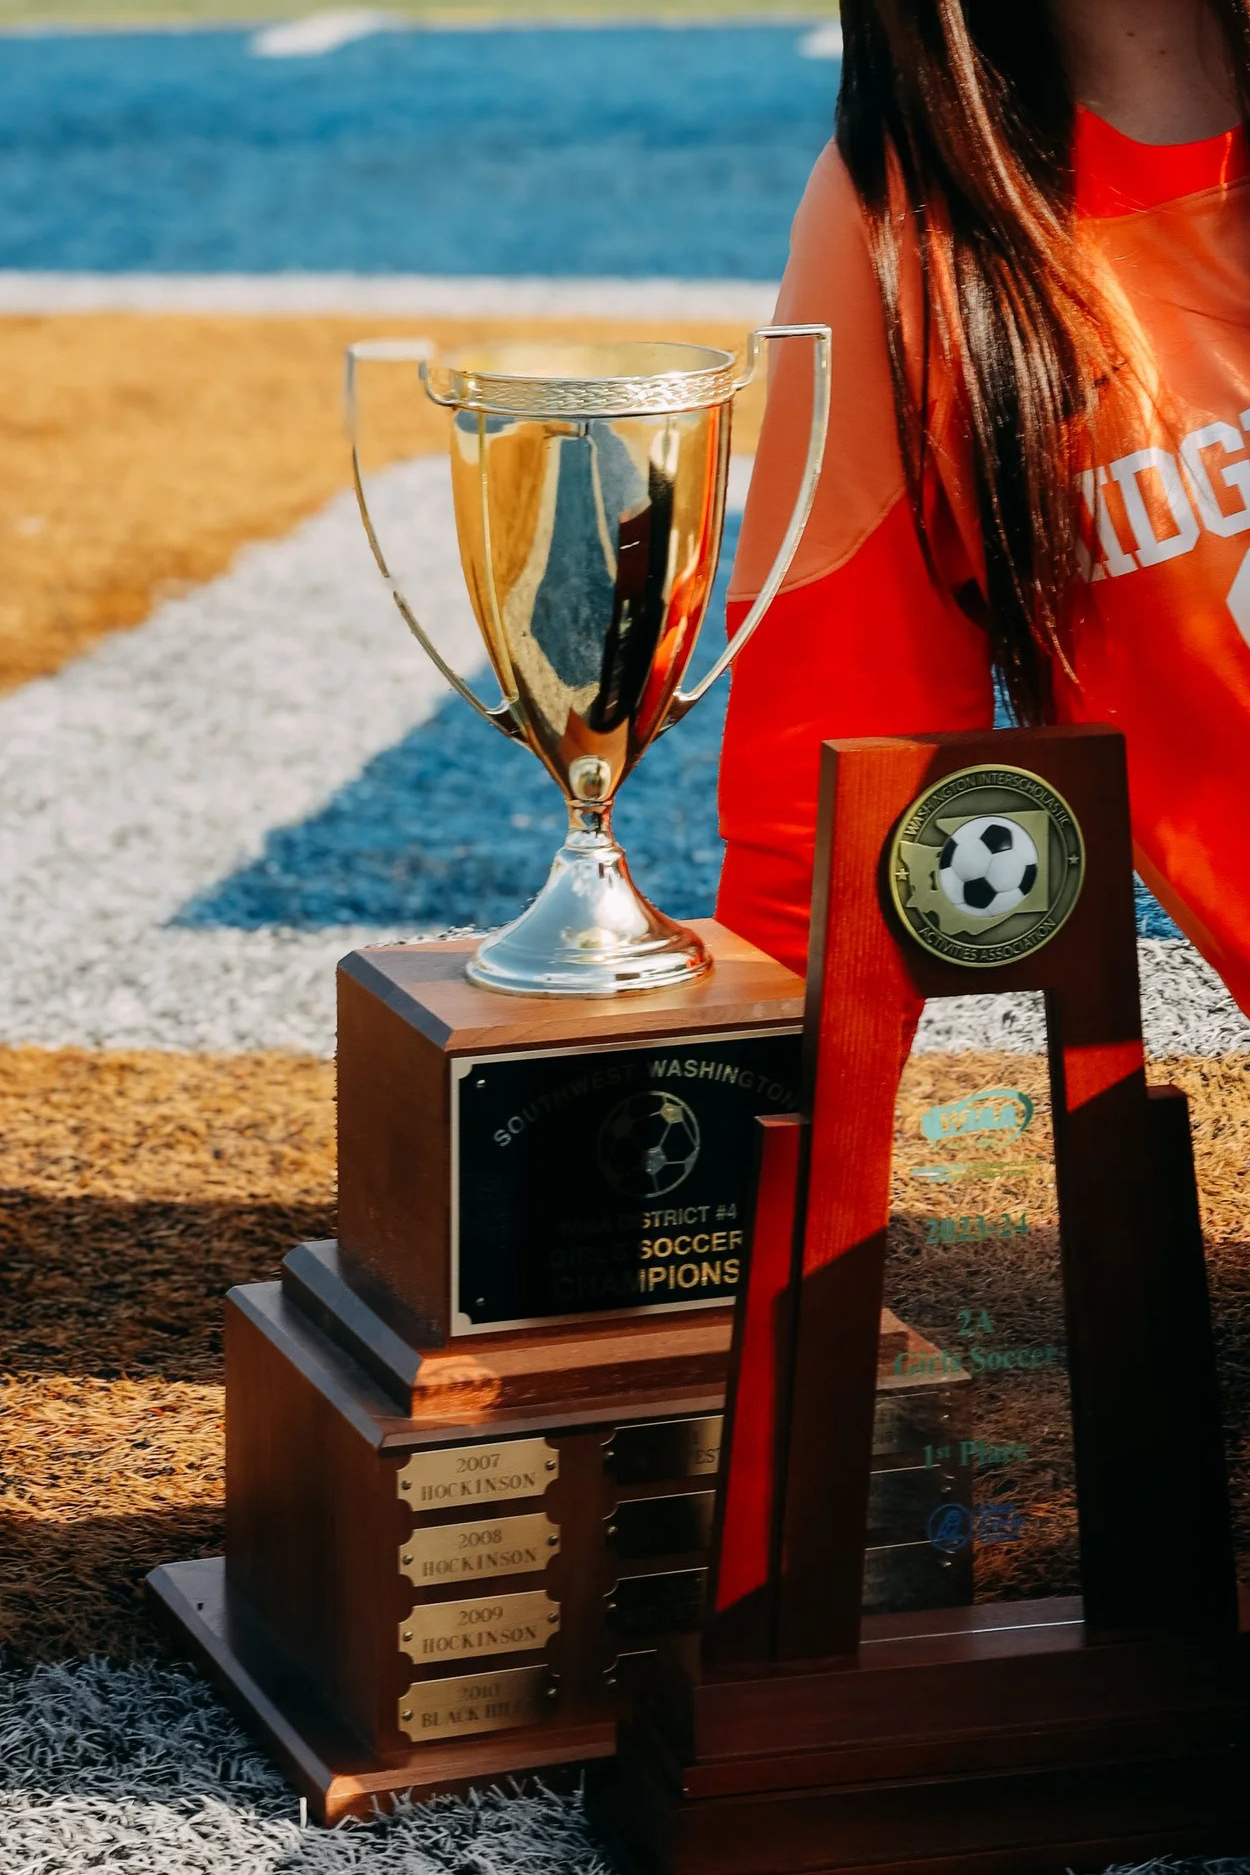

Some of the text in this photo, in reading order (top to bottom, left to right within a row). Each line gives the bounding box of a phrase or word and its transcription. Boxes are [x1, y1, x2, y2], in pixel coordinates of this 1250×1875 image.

[905, 773, 1071, 836] WASHINGTON INTERSCHOLASTIC
[919, 918, 1056, 961] ACTIVITIES ASSOCIATION
[649, 1059, 798, 1110] WASHINGTON
[715, 1203, 738, 1221] #4
[925, 1212, 1029, 1244] 2023-24
[637, 1230, 744, 1260] SOCCER
[957, 1308, 996, 1336] 2A
[893, 1345, 1067, 1376] Girls Soccer
[456, 1453, 502, 1474] 2007
[922, 1443, 950, 1469] 1st
[421, 1471, 537, 1501] HOCKINSON
[458, 1529, 503, 1549] 2008
[422, 1546, 539, 1577] HOCKINSON
[458, 1606, 504, 1626] 2009
[422, 1625, 539, 1654] HOCKINSON
[460, 1682, 500, 1701] 2010
[421, 1705, 480, 1728] BLACK
